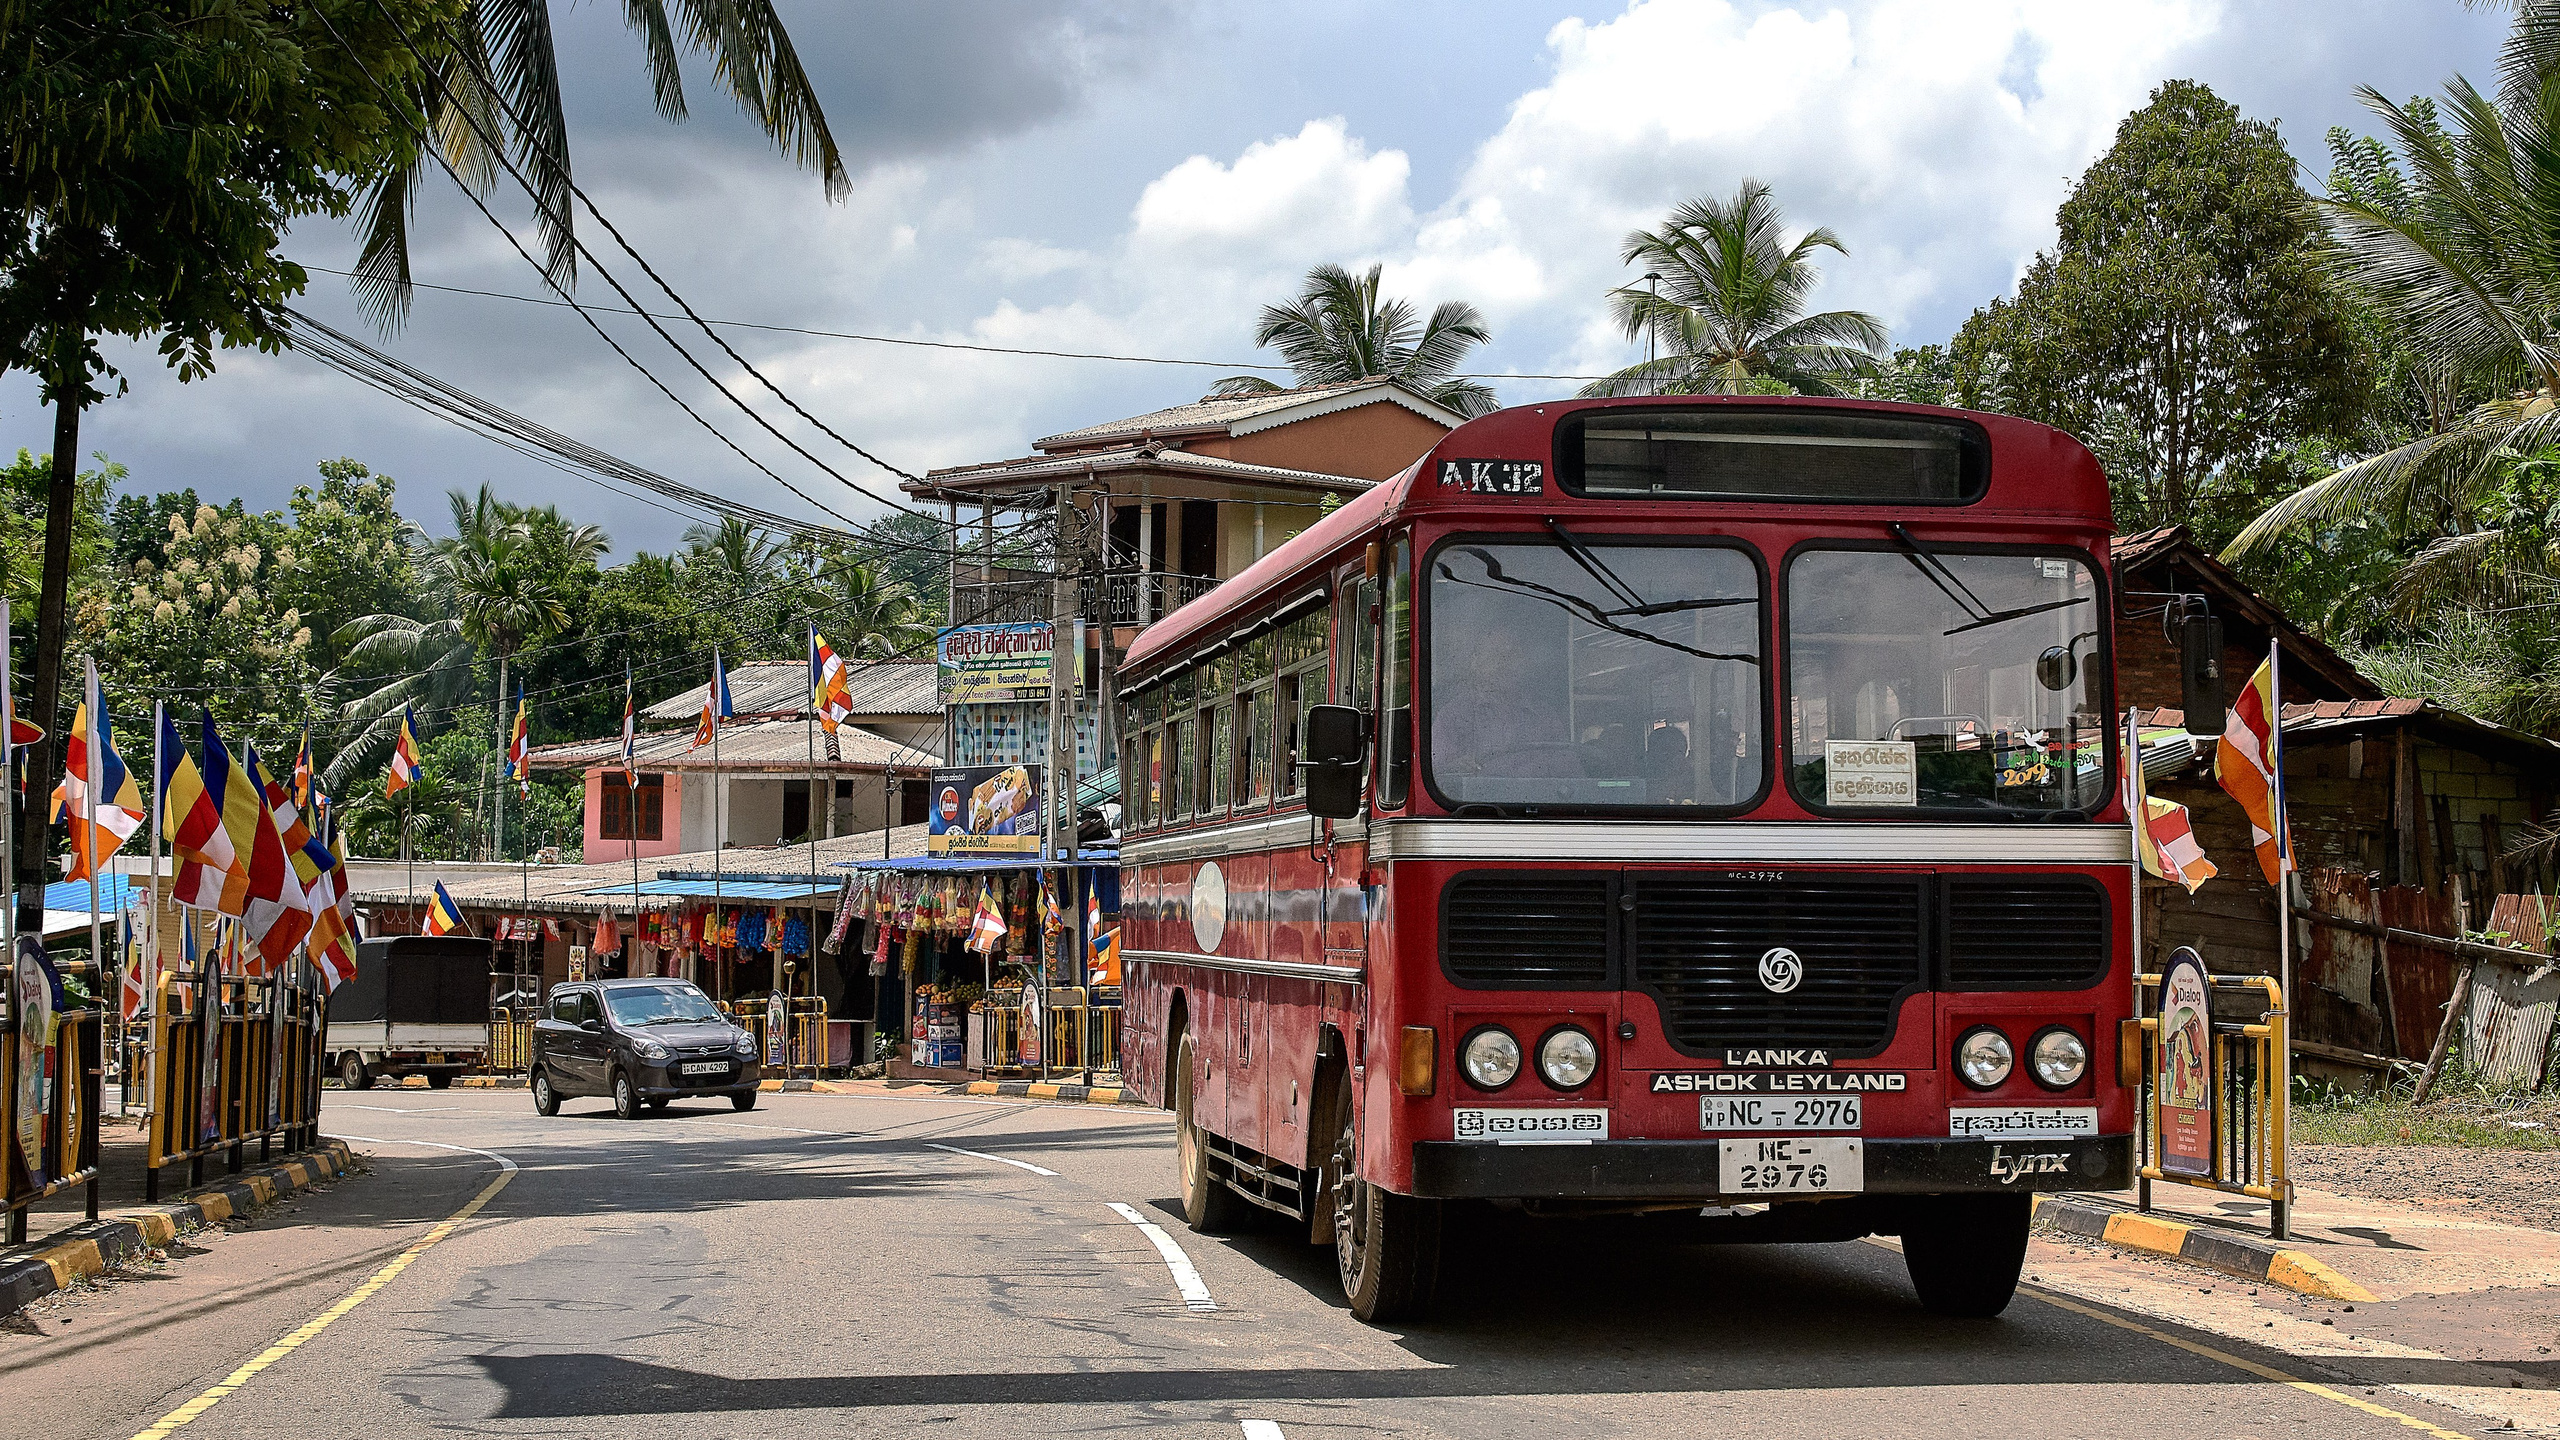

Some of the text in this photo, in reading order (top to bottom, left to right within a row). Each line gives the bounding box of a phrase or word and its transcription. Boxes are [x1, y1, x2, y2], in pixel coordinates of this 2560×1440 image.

[2003, 763, 2047, 786] 2019
[1774, 962, 1789, 976] L
[2179, 987, 2201, 1006] Dialog
[1726, 1049, 1829, 1066] LANKA
[690, 1062, 728, 1073] CAN 4292
[1652, 1074, 1907, 1092] ASHOK LEYLAND
[1990, 1145, 2071, 1185] Lynx
[1740, 1163, 1828, 1189] 2976
